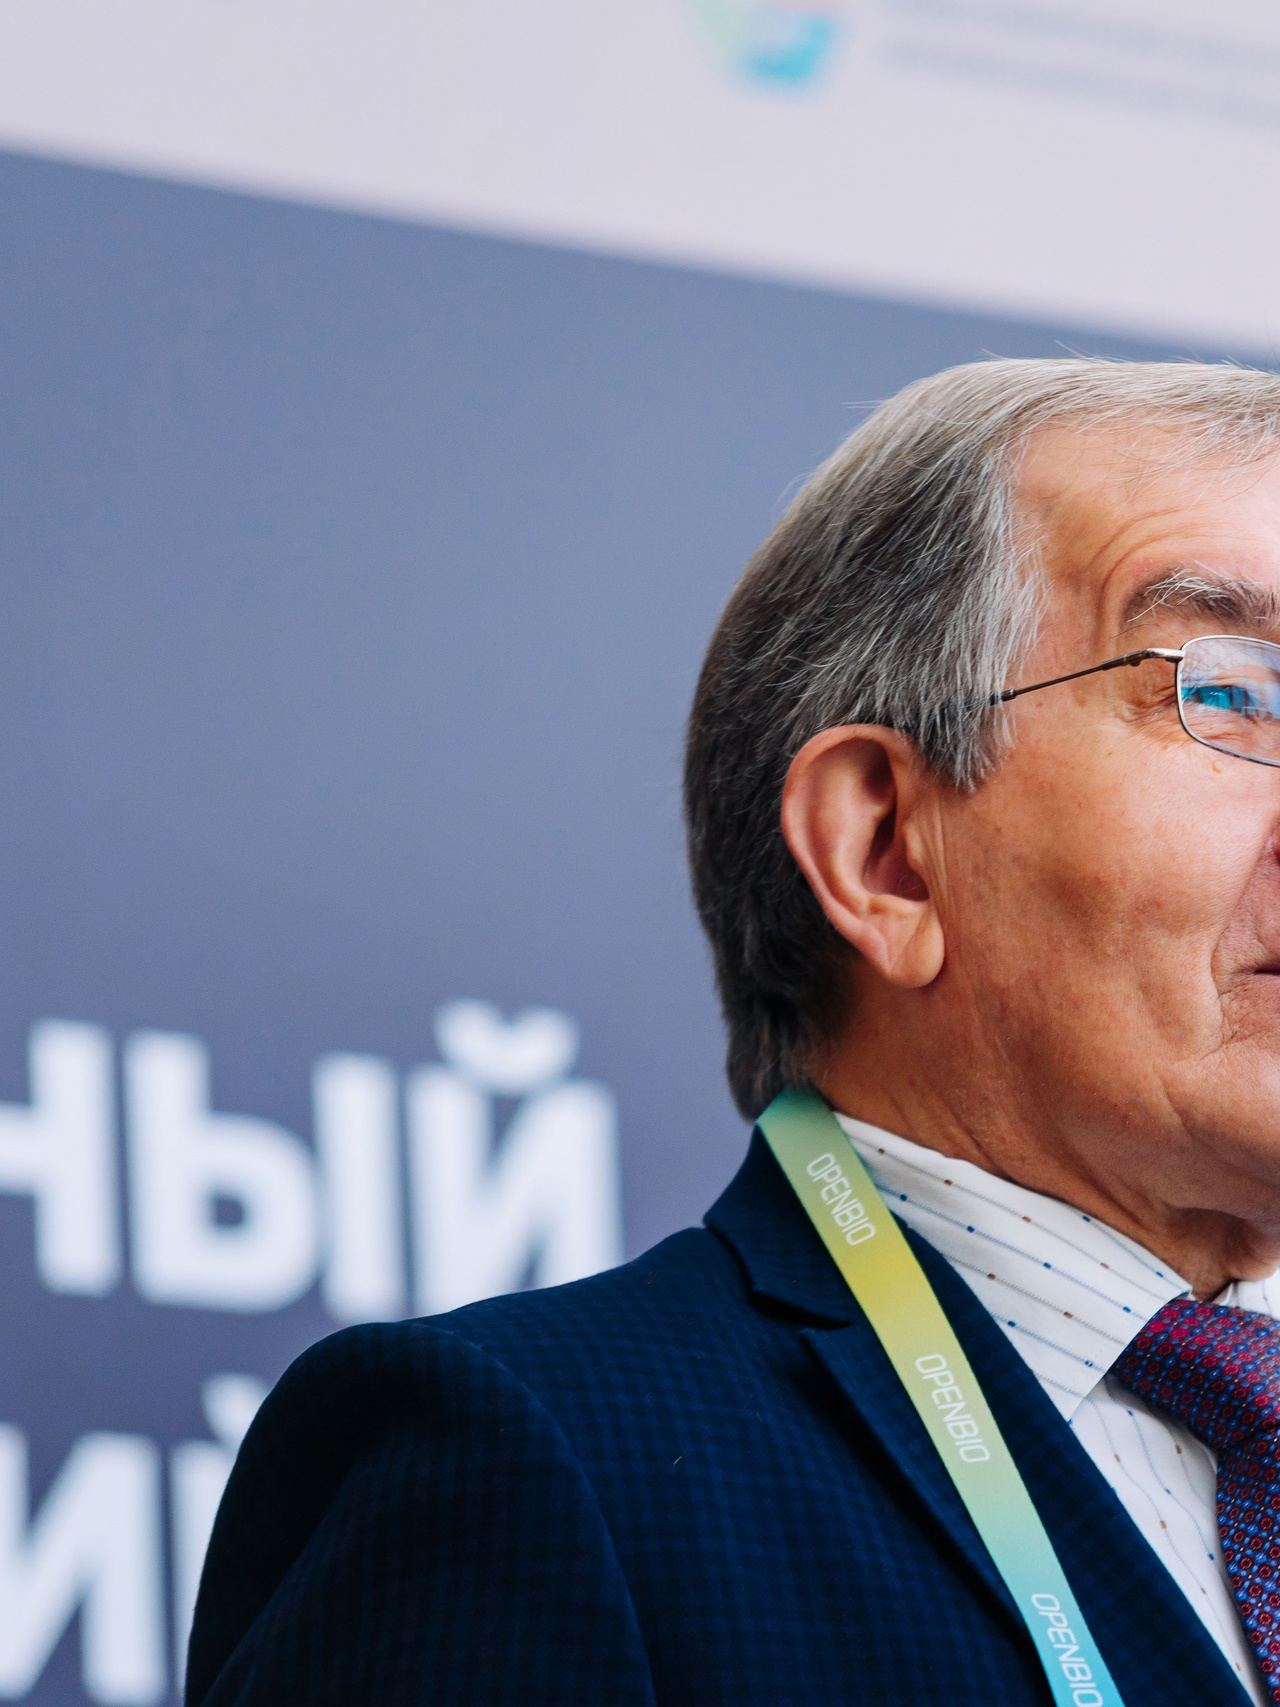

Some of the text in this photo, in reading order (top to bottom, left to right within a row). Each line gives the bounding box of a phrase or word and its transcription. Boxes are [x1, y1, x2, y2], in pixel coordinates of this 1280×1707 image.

[806, 1152, 877, 1247] OPENBIO
[914, 1353, 991, 1464] OPENBIO
[1031, 1593, 1104, 1707] OPENBIO
